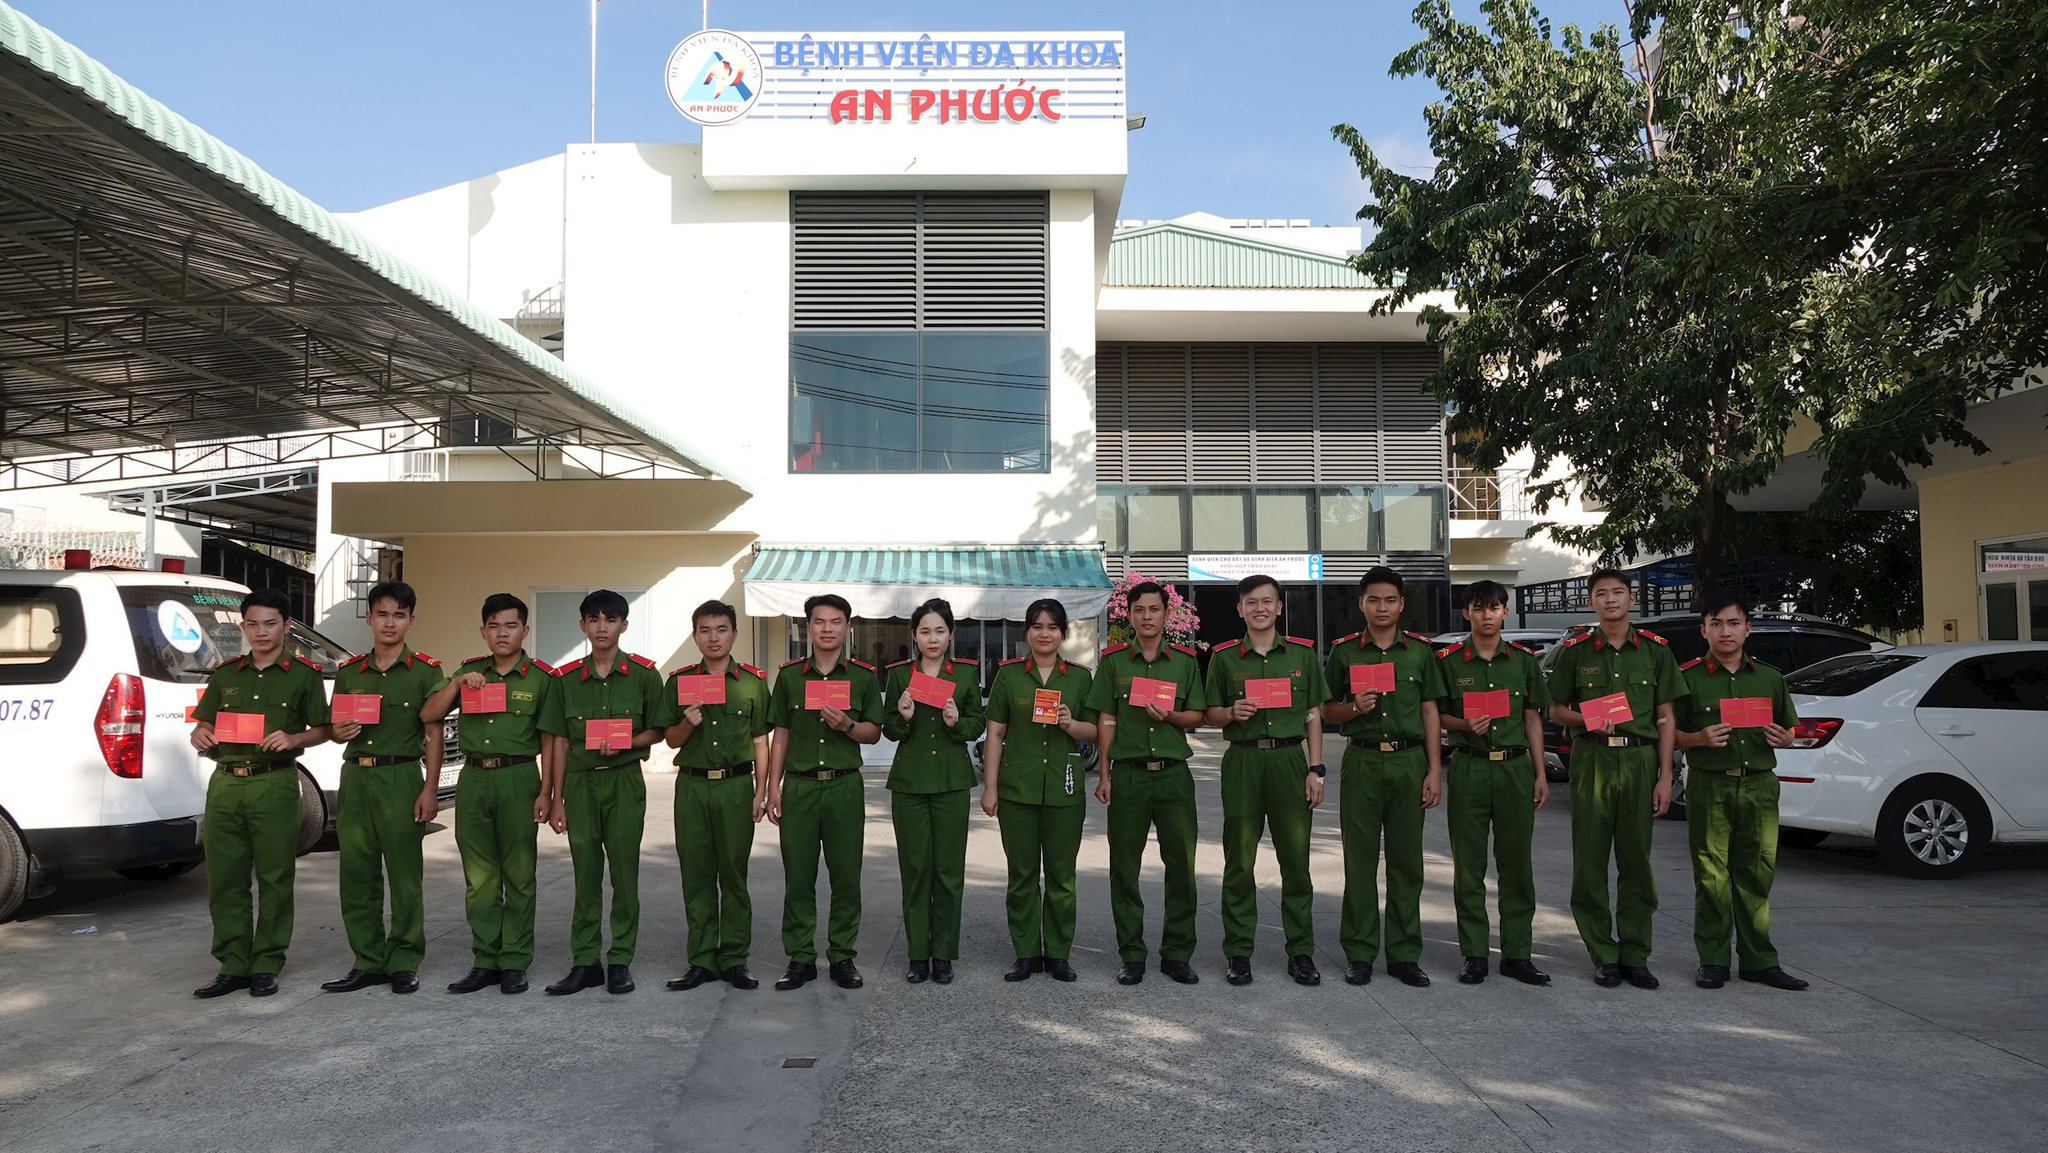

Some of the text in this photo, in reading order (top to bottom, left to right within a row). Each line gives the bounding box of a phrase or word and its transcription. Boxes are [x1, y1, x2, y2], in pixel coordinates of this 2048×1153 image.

[775, 33, 1121, 73] BỆNH VIỆN ĐA KHOA
[830, 78, 1061, 125] AN PHƯỚC
